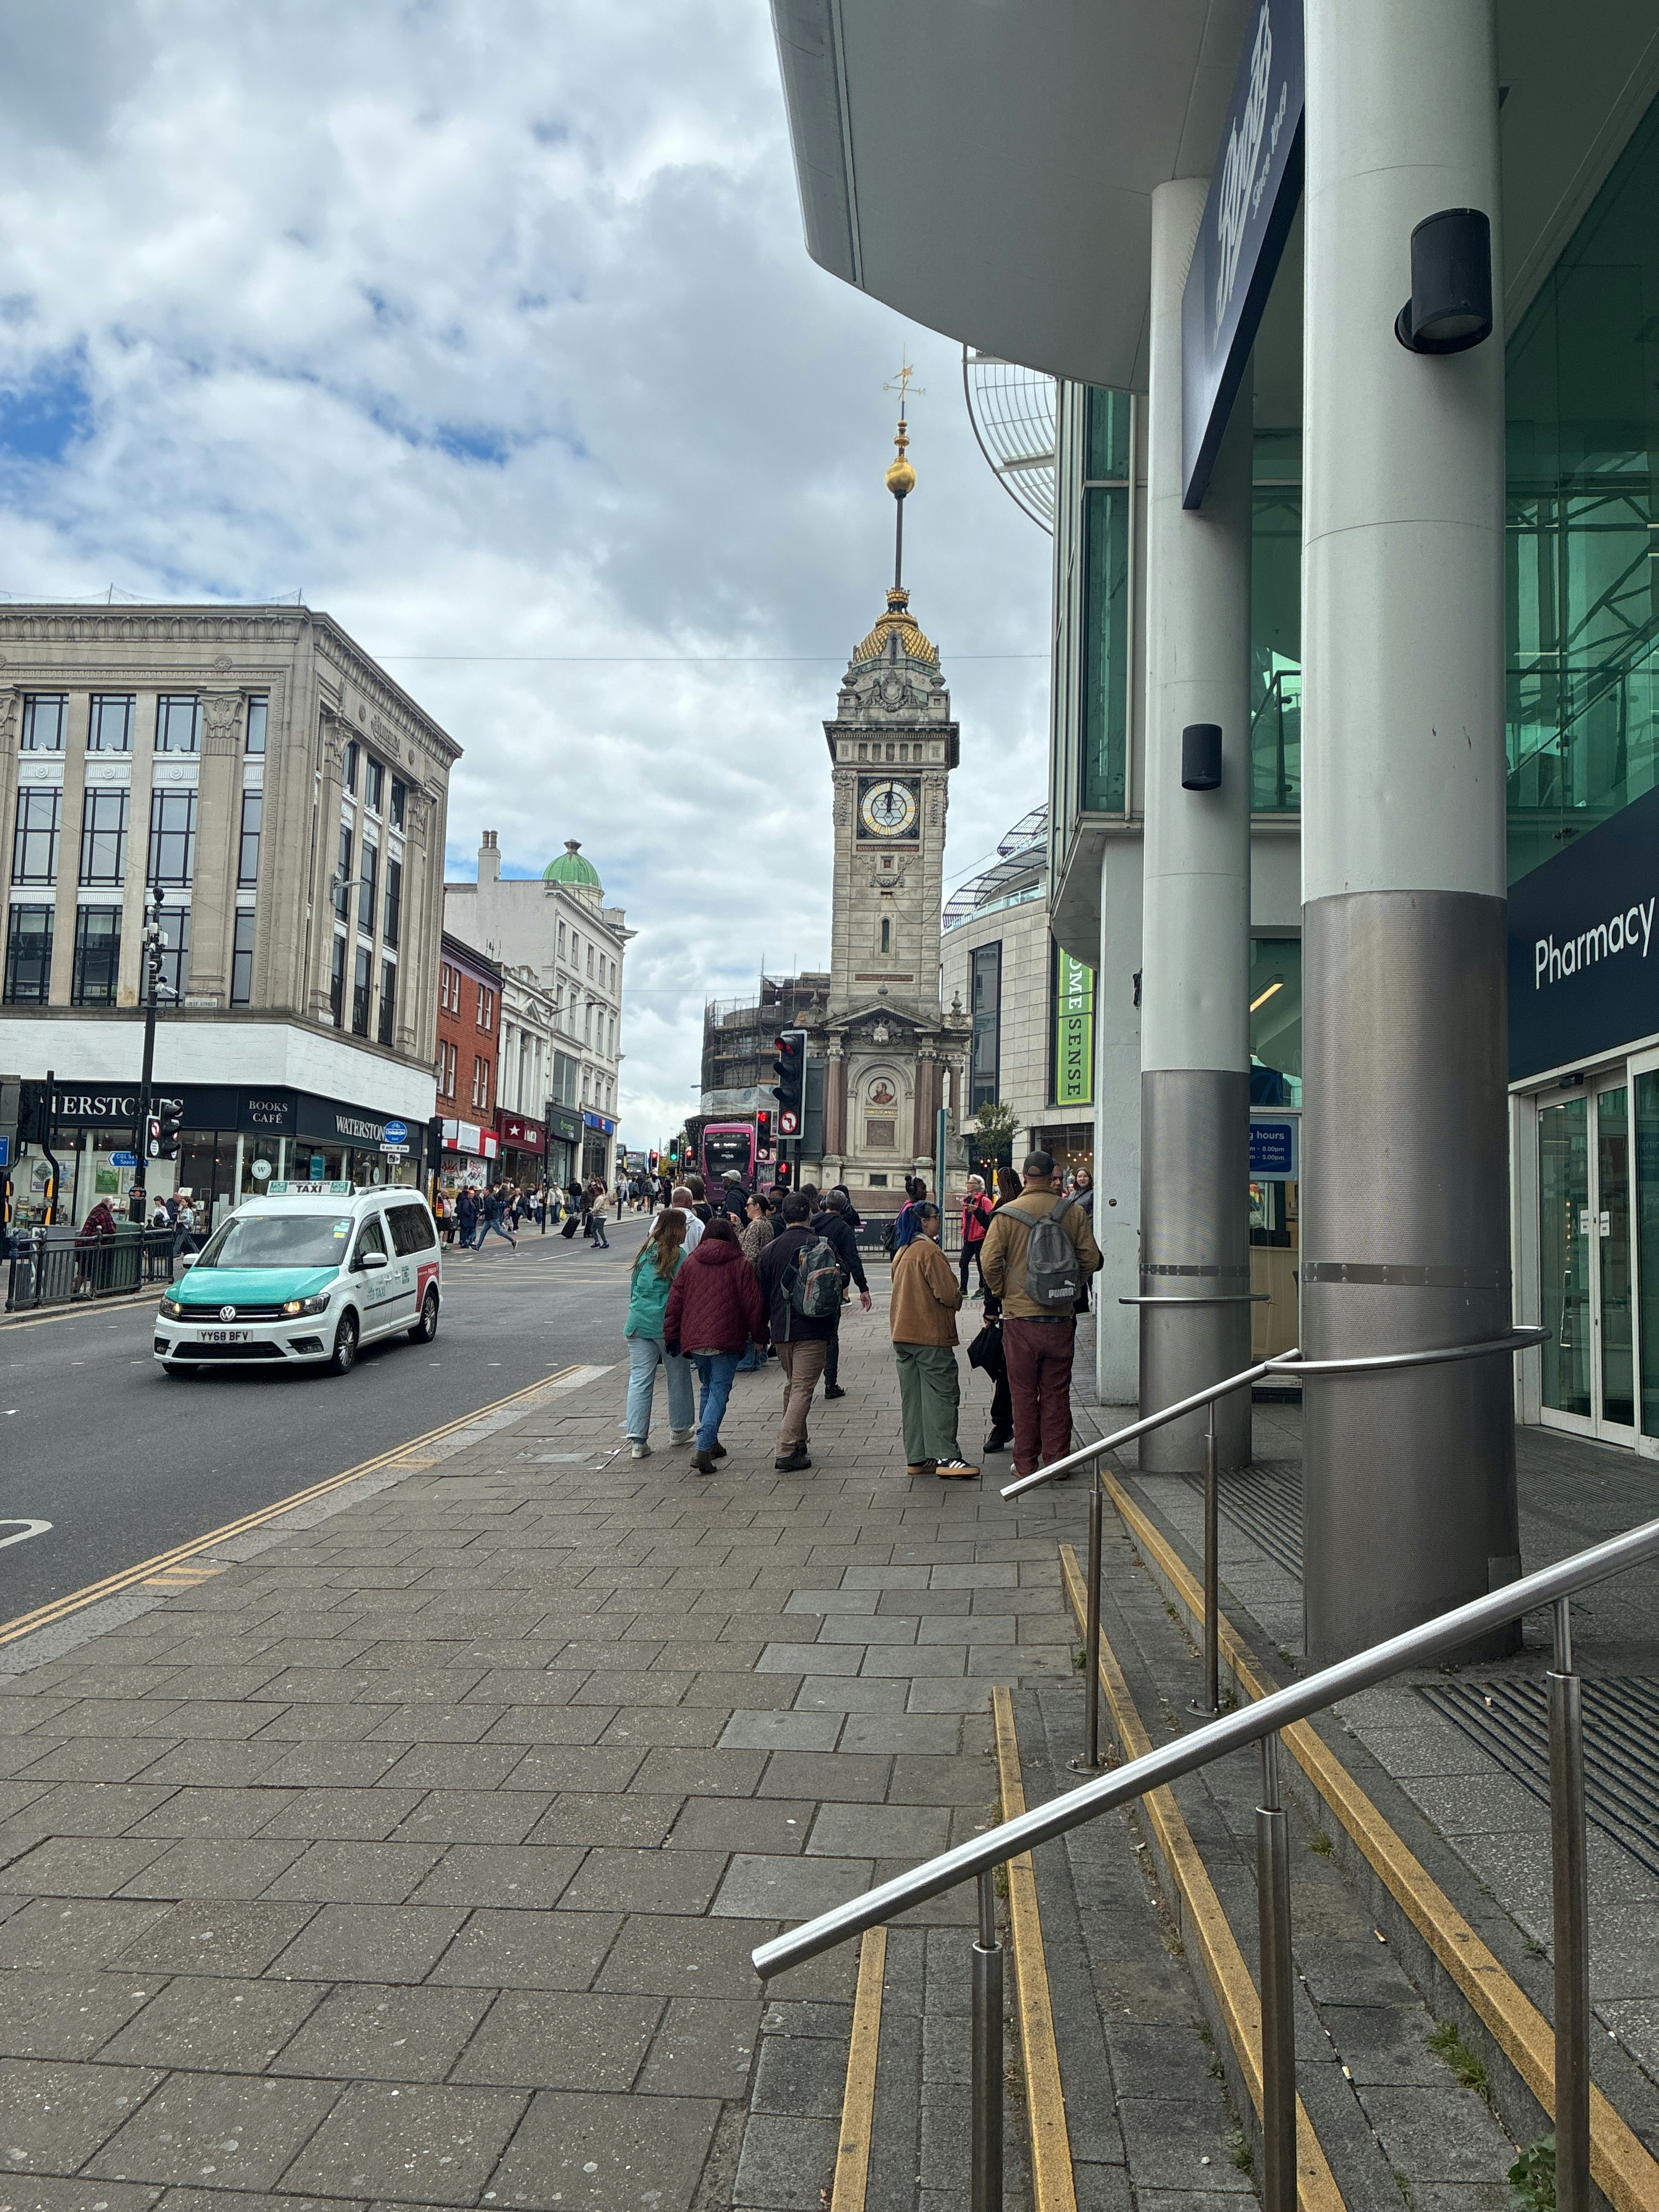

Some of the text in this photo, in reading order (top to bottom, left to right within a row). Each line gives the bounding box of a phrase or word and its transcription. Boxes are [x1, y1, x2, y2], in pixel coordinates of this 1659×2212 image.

[1252, 81, 1287, 219] Since 1849
[1214, 0, 1272, 351] Boots
[1536, 896, 1655, 990] Pharmacy
[1068, 957, 1082, 1096] OME SENSE
[249, 1100, 288, 1112] BOOKS
[252, 1113, 283, 1124] CAFÉ
[335, 1115, 387, 1142] WATERSTON
[1256, 1131, 1285, 1140] hours
[1048, 1287, 1074, 1299] PUMA
[201, 1331, 249, 1341] YY68 BFV
